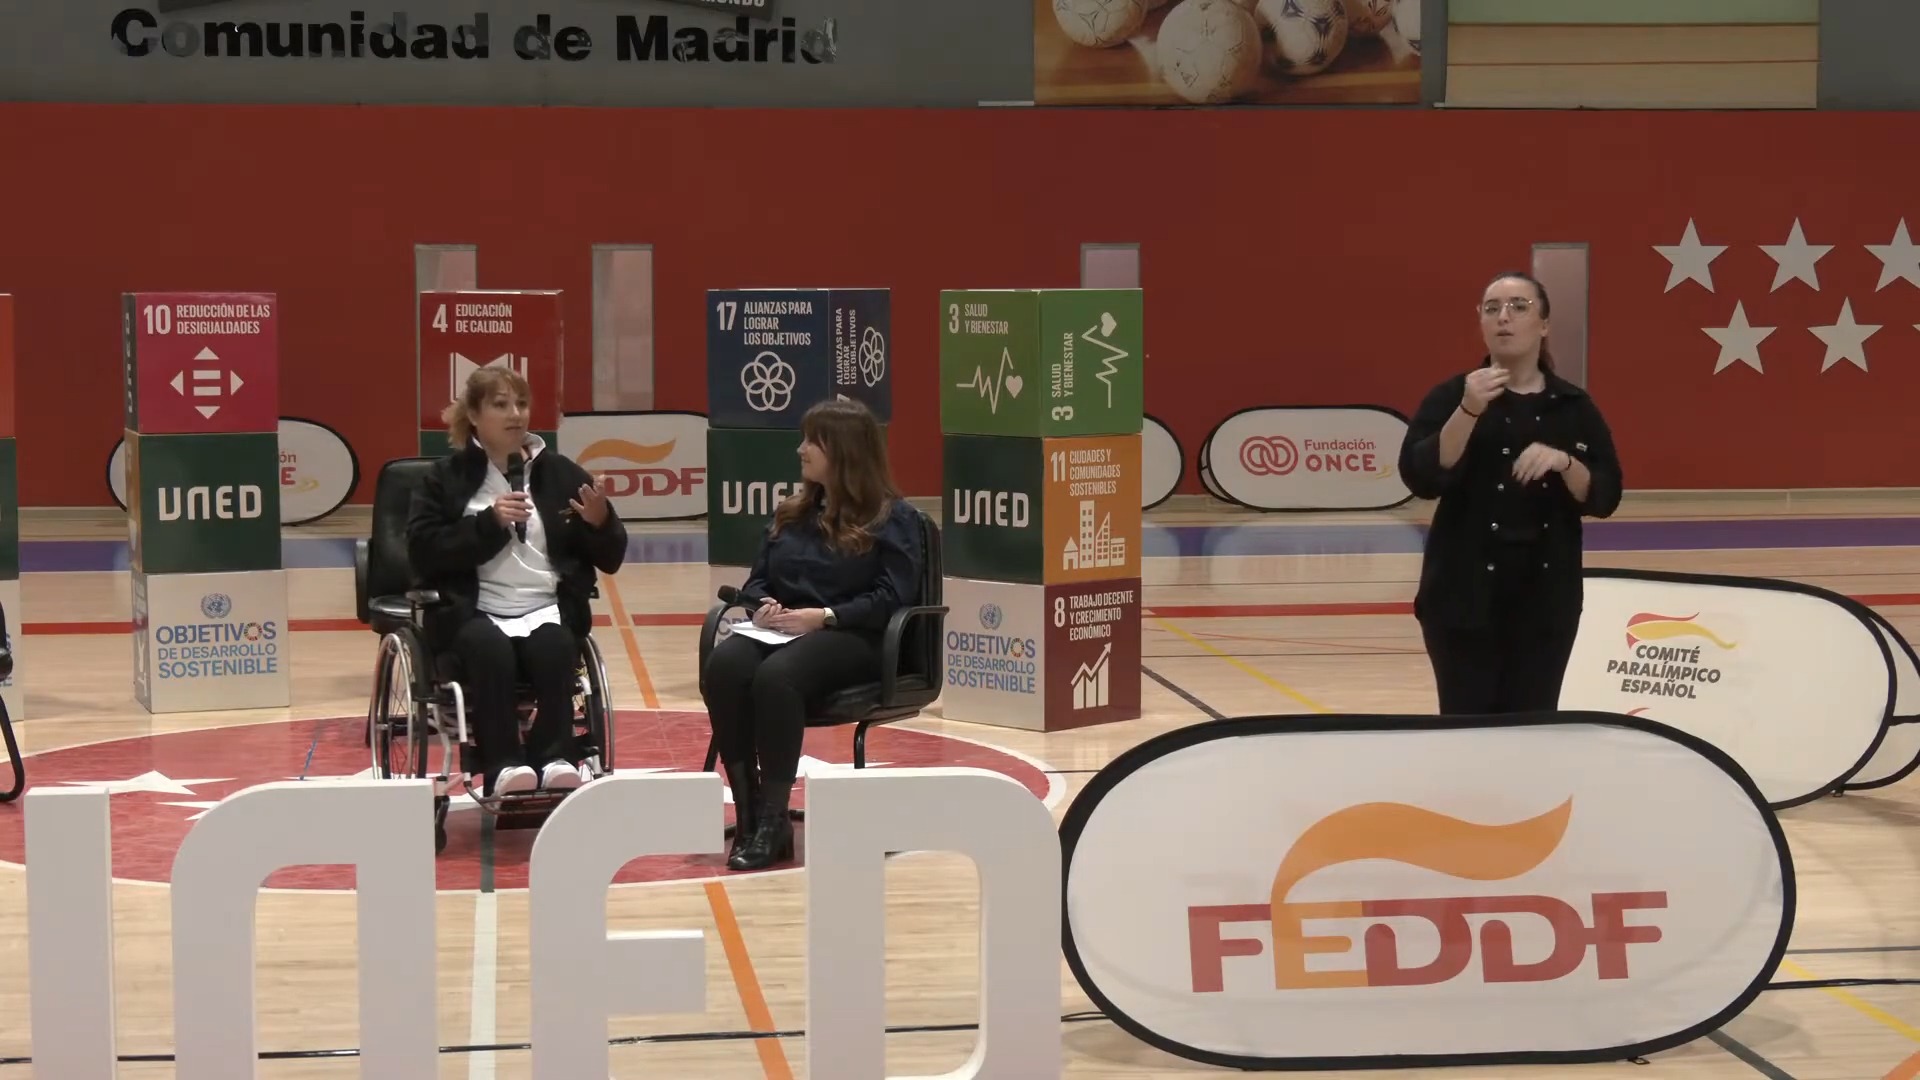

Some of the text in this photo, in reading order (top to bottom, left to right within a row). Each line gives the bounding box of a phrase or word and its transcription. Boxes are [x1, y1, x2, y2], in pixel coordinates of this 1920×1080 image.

[111, 8, 837, 63] Comunidad de Madrid
[176, 303, 270, 319] REDUCCIÓN DE LAS
[432, 304, 448, 332] 4
[456, 302, 512, 318] EDUCACIÓN
[717, 301, 737, 331] 17
[744, 301, 812, 315] ALIANZAS PARA
[965, 304, 987, 317] SALUD
[143, 304, 171, 335] 10
[176, 320, 260, 335] DESIGUALDADES
[456, 320, 512, 333] DE CALIDAD
[744, 317, 779, 330] LOGRAR
[949, 304, 959, 333] 3
[965, 321, 1008, 335] Y BIENESTAR
[744, 333, 811, 345] LOS OBJETIVOS
[849, 310, 857, 364] OBJETIVOS
[1064, 332, 1073, 390] BIENESTAR
[1052, 363, 1061, 398] SALUD
[1052, 406, 1073, 421] 3
[1304, 438, 1375, 451] Fundación
[1051, 451, 1066, 482] 11
[1069, 449, 1111, 464] CIUDADES Y
[1305, 454, 1376, 472] ONCE
[598, 467, 706, 497] DDF
[1069, 464, 1120, 480] COMUNIDADES
[1069, 481, 1116, 496] SOSTENIBLES
[158, 484, 262, 521] UNED
[954, 489, 1029, 528] UNED
[1070, 590, 1134, 610] TRABAJO DECENTE
[1054, 597, 1065, 628] 8
[1070, 608, 1121, 624] Y CRECIMIENTO
[156, 621, 276, 644] OBJETIVOS
[1069, 624, 1111, 641] ECONÓMICO
[158, 643, 276, 660] DE DESARROLLO
[947, 631, 1035, 659] OBJETIVOS
[1636, 645, 1701, 664] COMITÉ
[158, 658, 277, 679] SOSTENIBLE
[948, 654, 1035, 674] DE DESARROLLO
[1607, 660, 1721, 684] PARALÍMPICO
[948, 668, 1035, 694] SOSTENIBLE
[1621, 678, 1697, 699] ESPAÑOL
[1187, 890, 1668, 993] FEDDF
